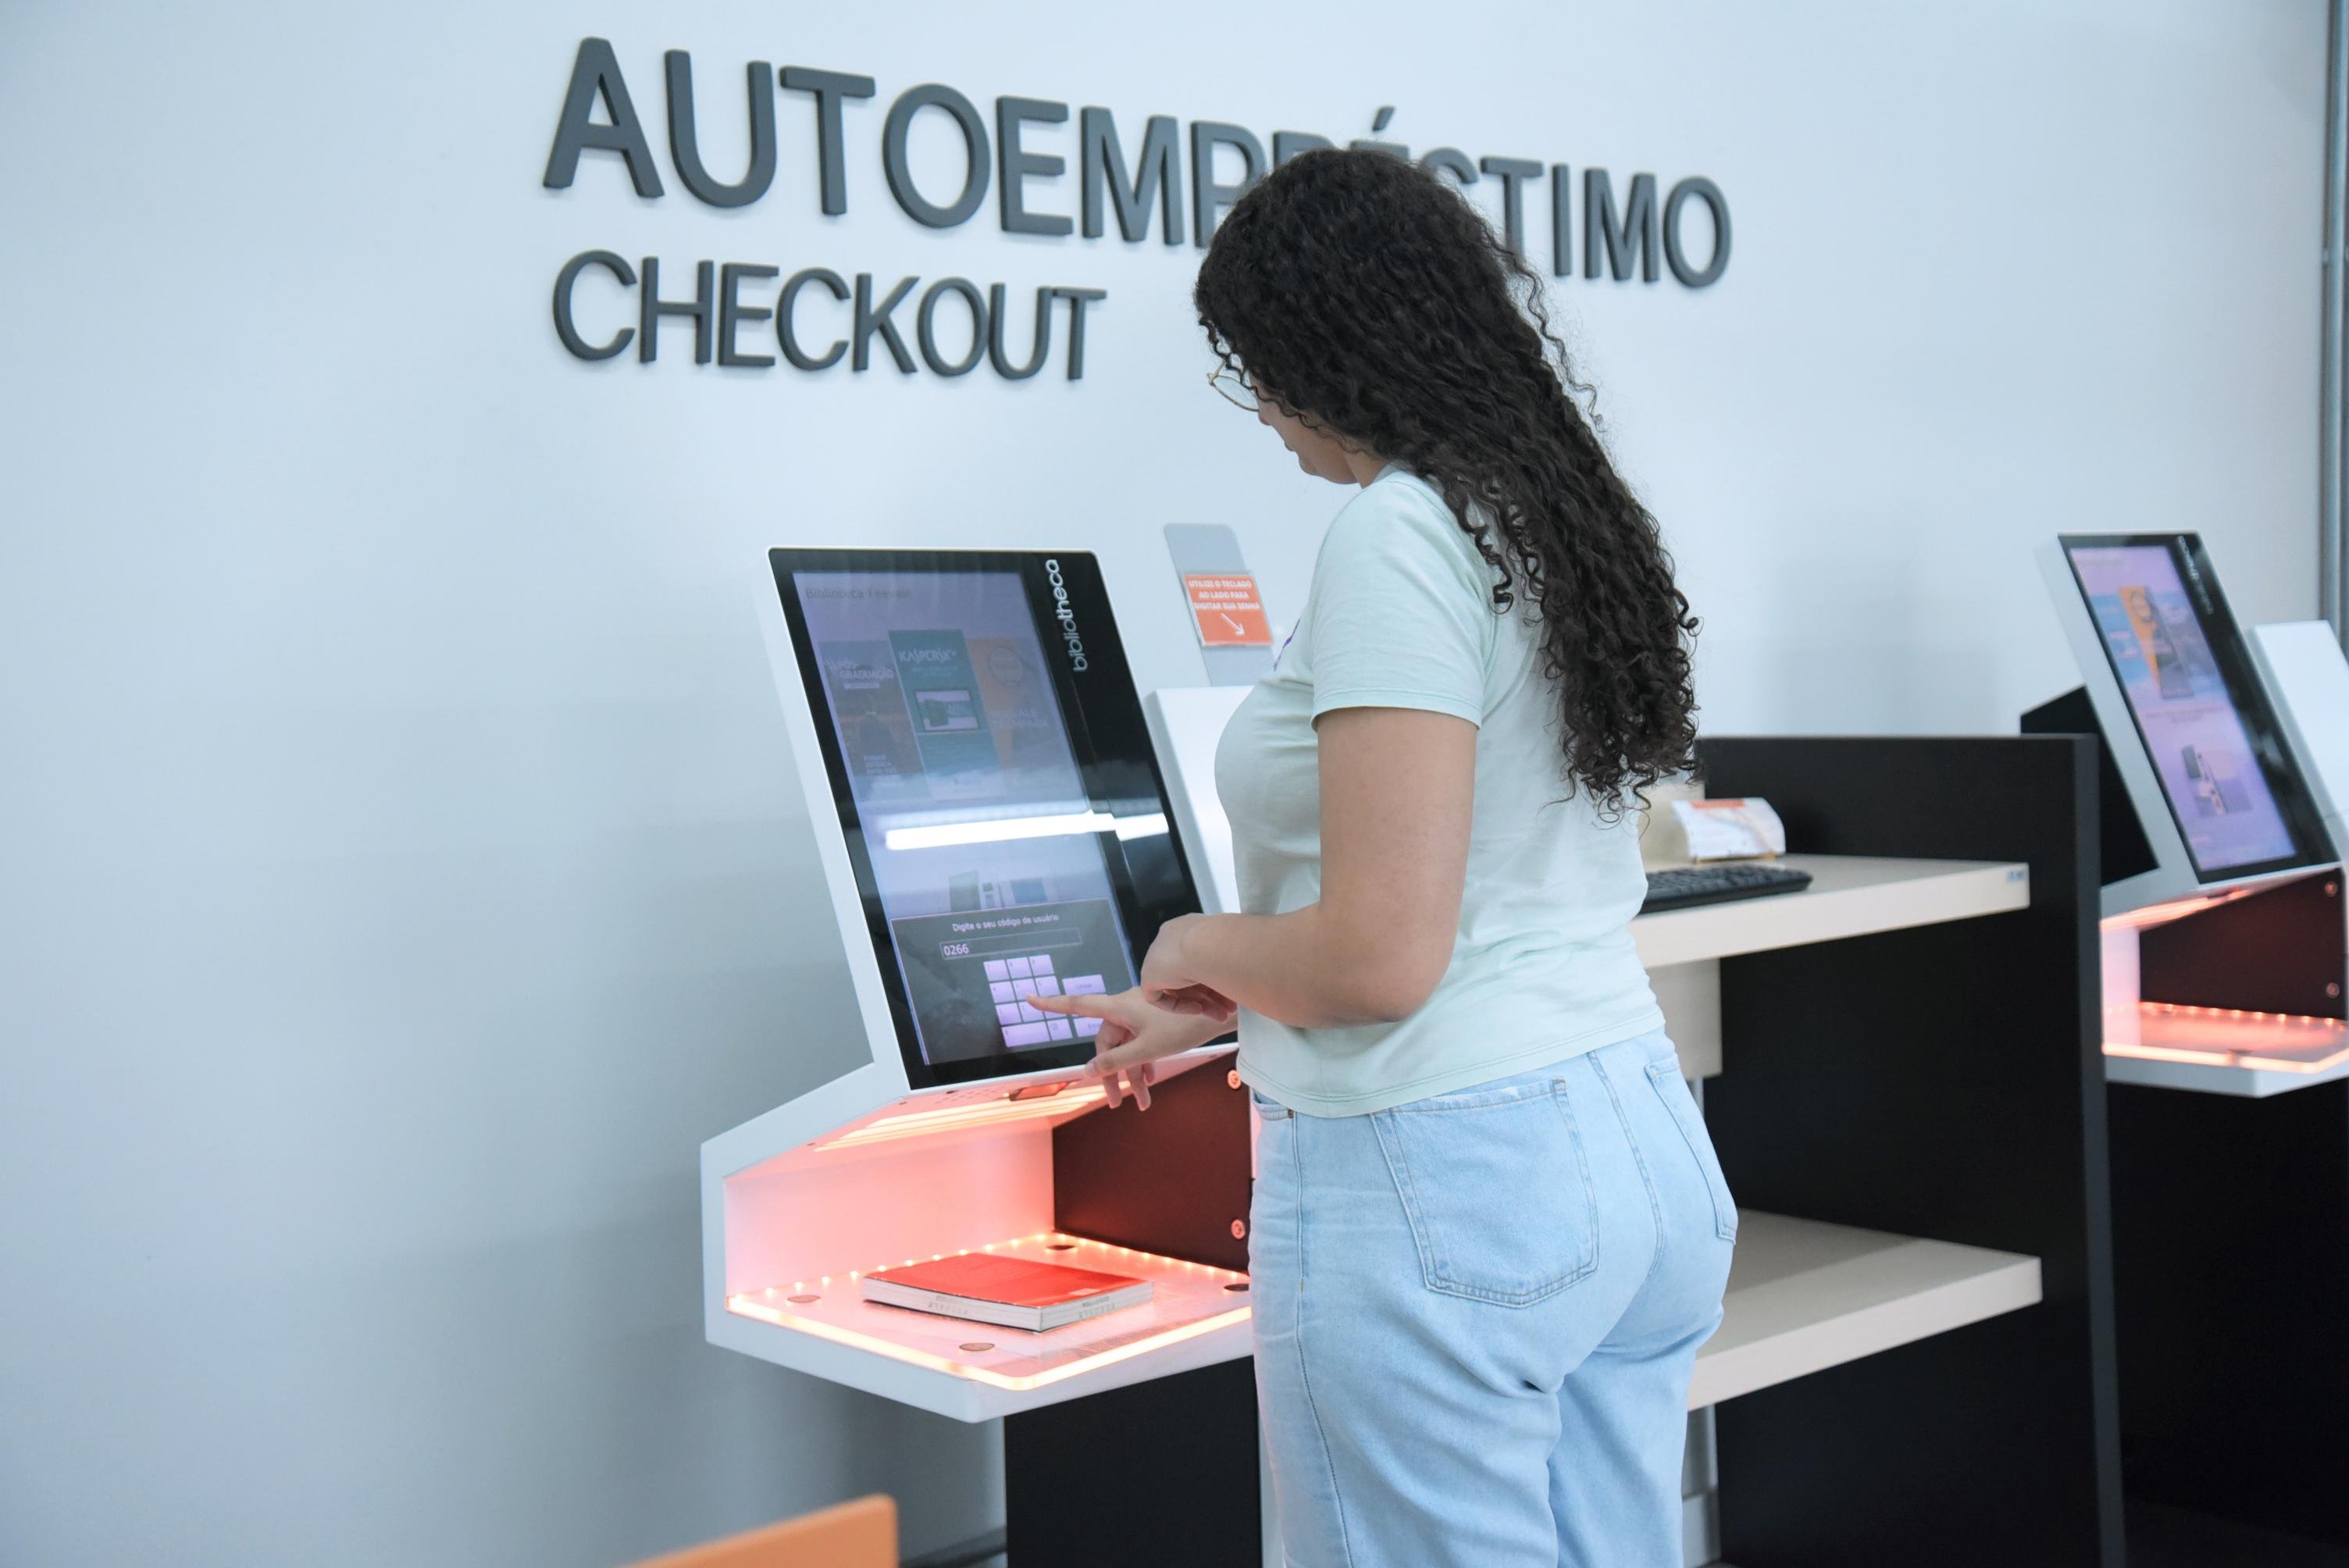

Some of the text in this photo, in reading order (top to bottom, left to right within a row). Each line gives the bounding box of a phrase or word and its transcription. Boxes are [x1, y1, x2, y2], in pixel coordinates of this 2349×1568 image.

[543, 36, 1731, 288] AUTOEMPTIMO
[553, 249, 1107, 380] CHECKOUT
[1045, 559, 1087, 672] bibliotheca
[899, 647, 957, 664] KASPERSKY
[943, 943, 970, 956] 0266
[952, 922, 975, 934] Digite
[983, 921, 996, 929] seu
[997, 917, 1021, 928] código
[1022, 916, 1032, 925] de
[1033, 913, 1059, 924] usuário
